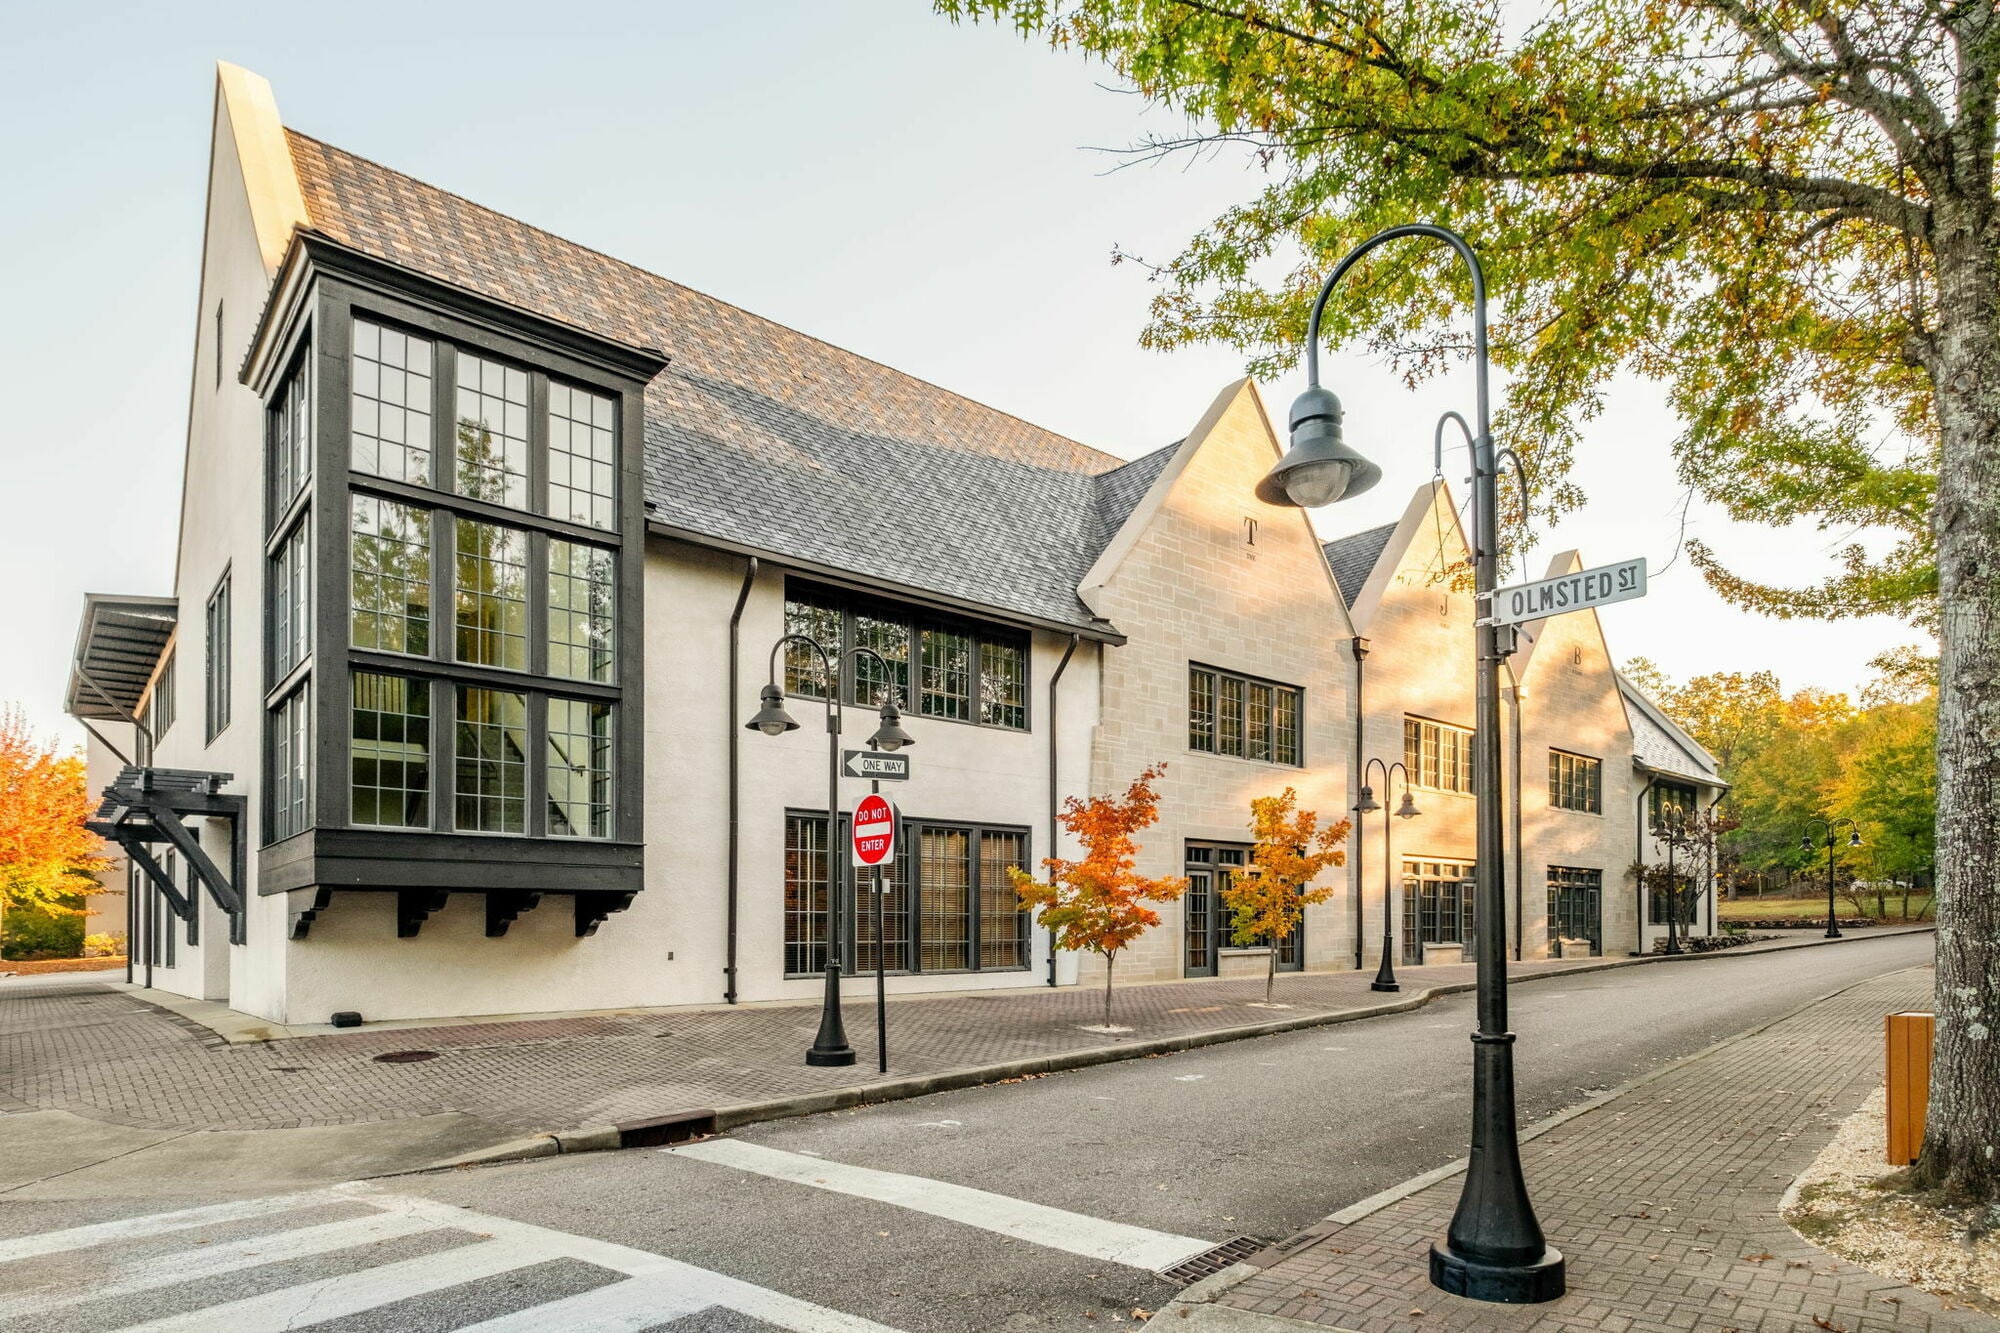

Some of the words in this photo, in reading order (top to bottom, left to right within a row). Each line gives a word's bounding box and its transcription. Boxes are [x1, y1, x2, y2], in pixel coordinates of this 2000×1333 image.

[1243, 516, 1258, 547] T
[1511, 572, 1613, 617] OLMSTED
[1618, 565, 1637, 589] ST
[1574, 646, 1582, 665] B
[863, 759, 881, 771] ONE
[884, 761, 902, 772] WAY
[858, 810, 869, 822] DO
[871, 807, 887, 820] NOT
[861, 839, 885, 852] ENTER
